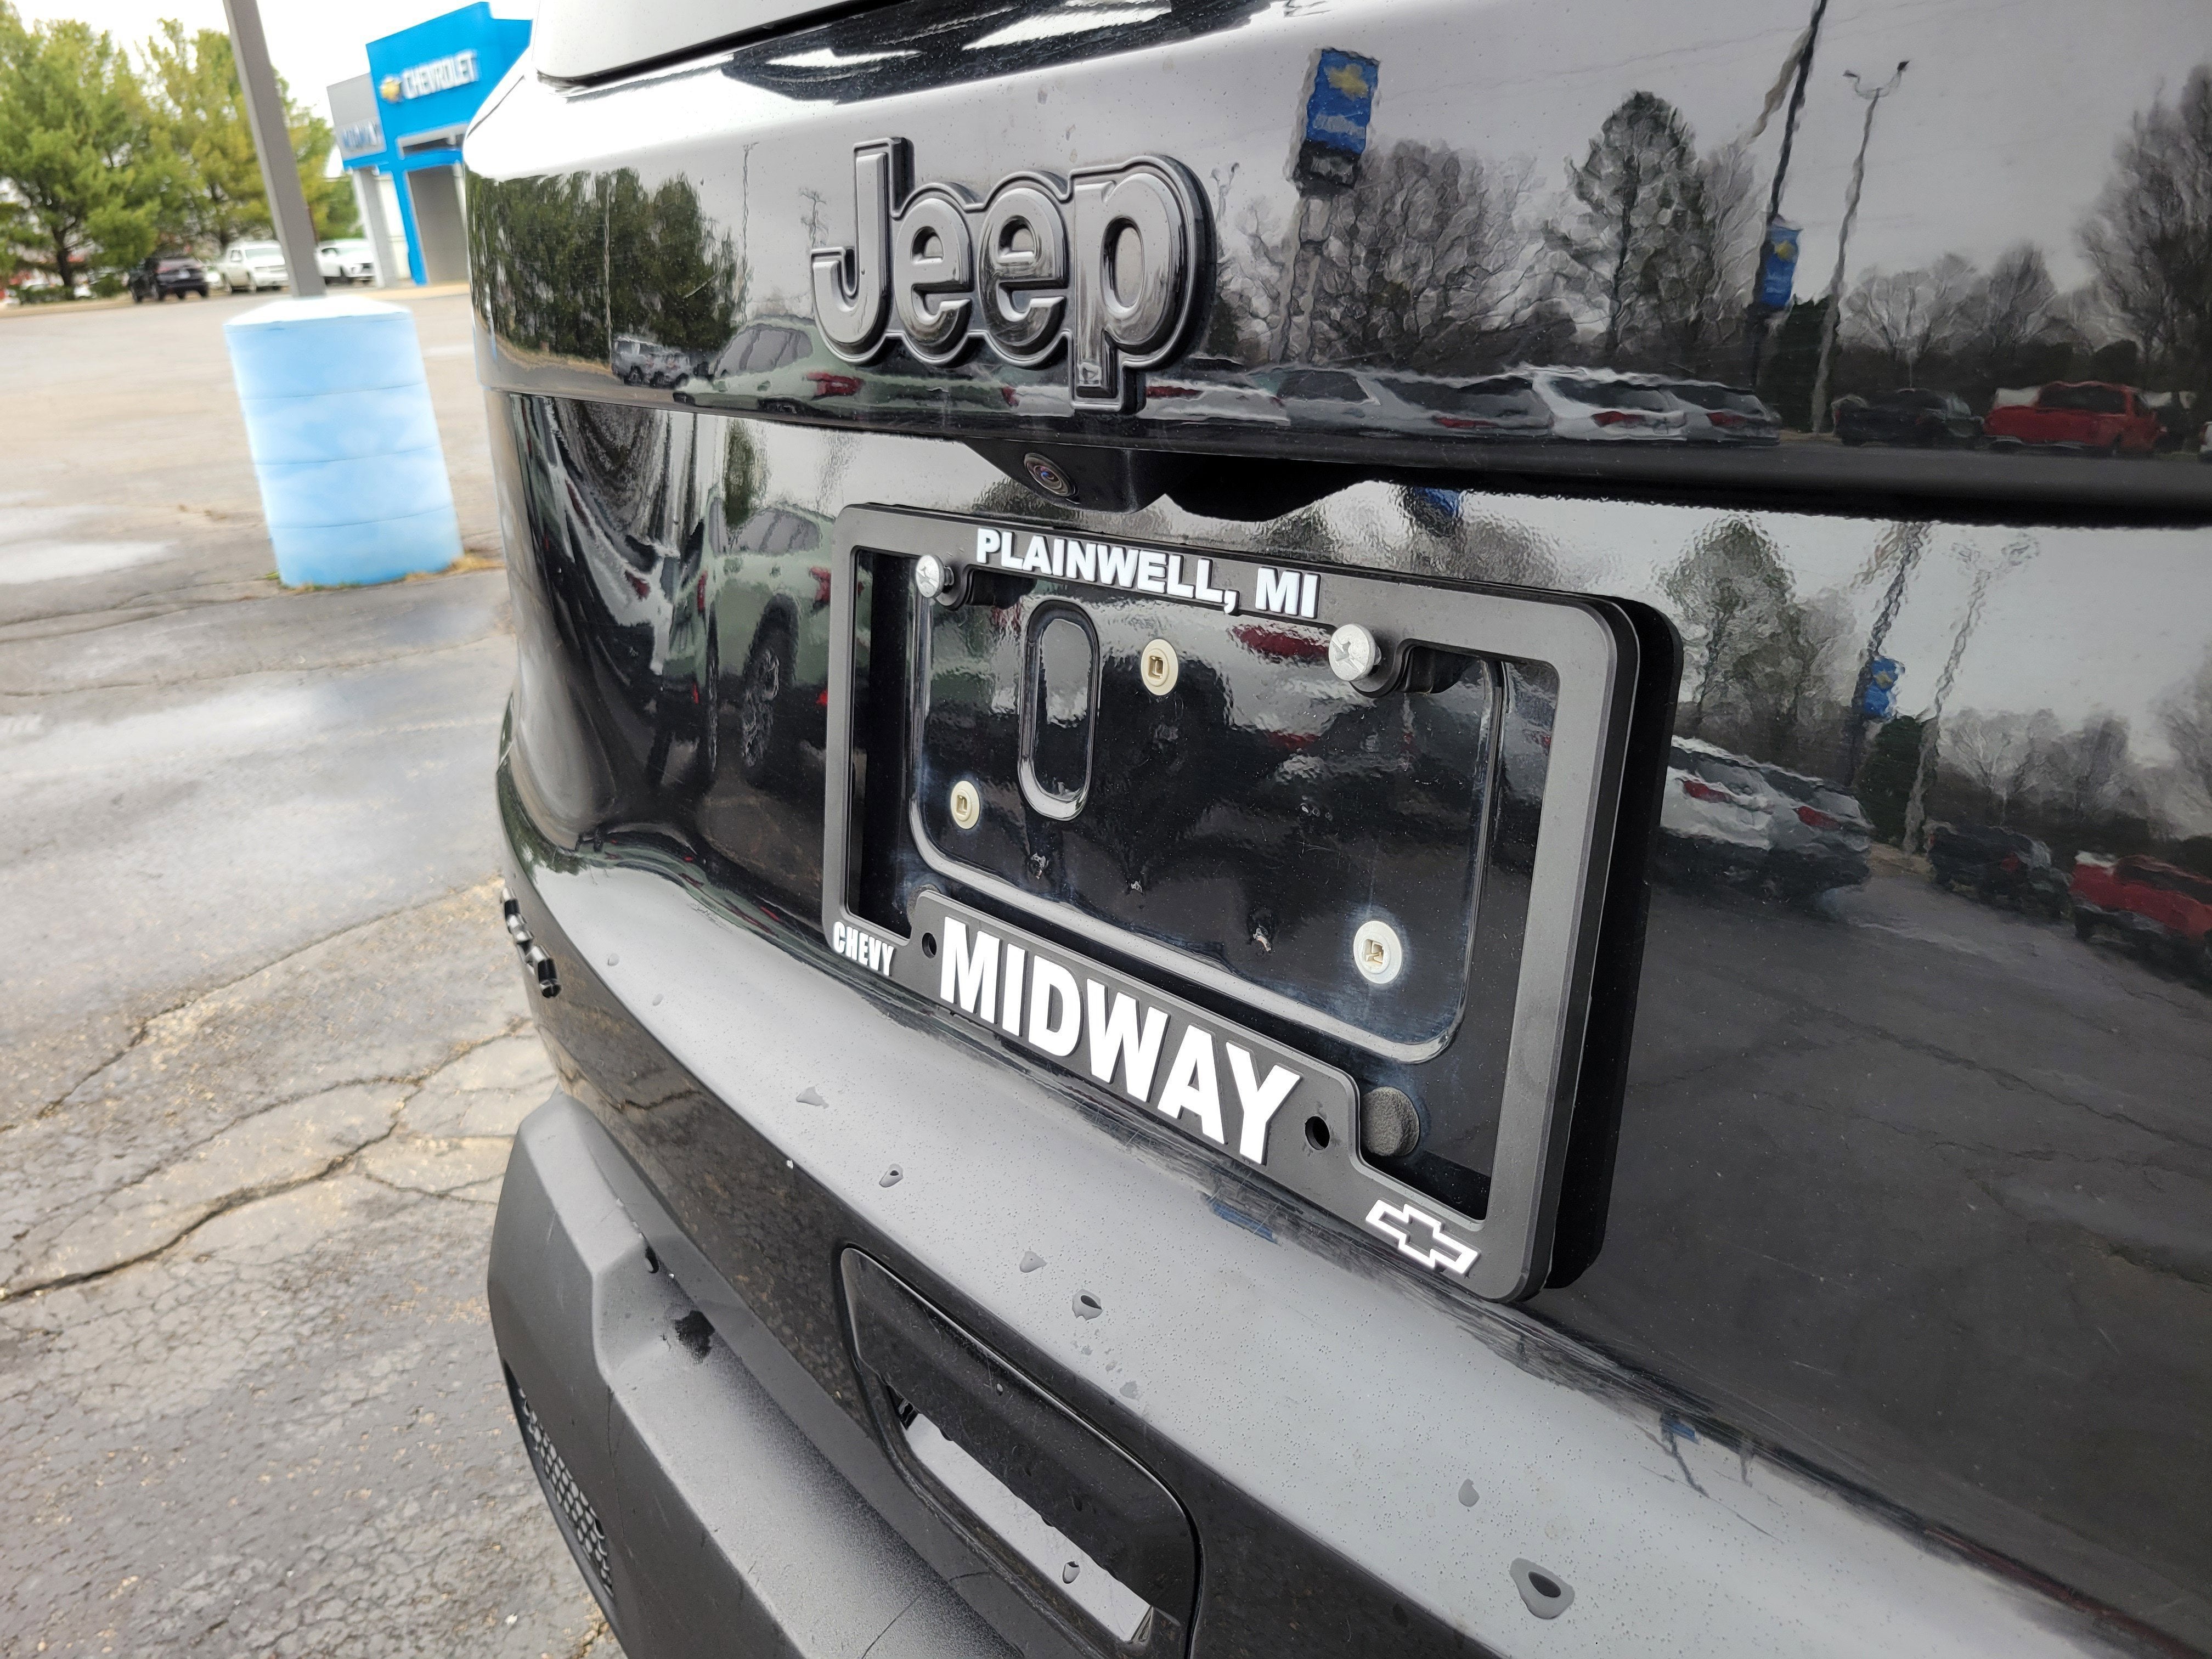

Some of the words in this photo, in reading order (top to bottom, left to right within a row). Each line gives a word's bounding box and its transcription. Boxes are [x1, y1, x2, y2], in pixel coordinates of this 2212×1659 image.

[402, 49, 478, 99] CHEVROLET
[811, 137, 1214, 414] Jeep
[977, 528, 1238, 614] PLAINWELL,
[1255, 567, 1319, 618] MI
[832, 921, 894, 977] CHEVY
[940, 916, 1301, 1165] MIDWAY
